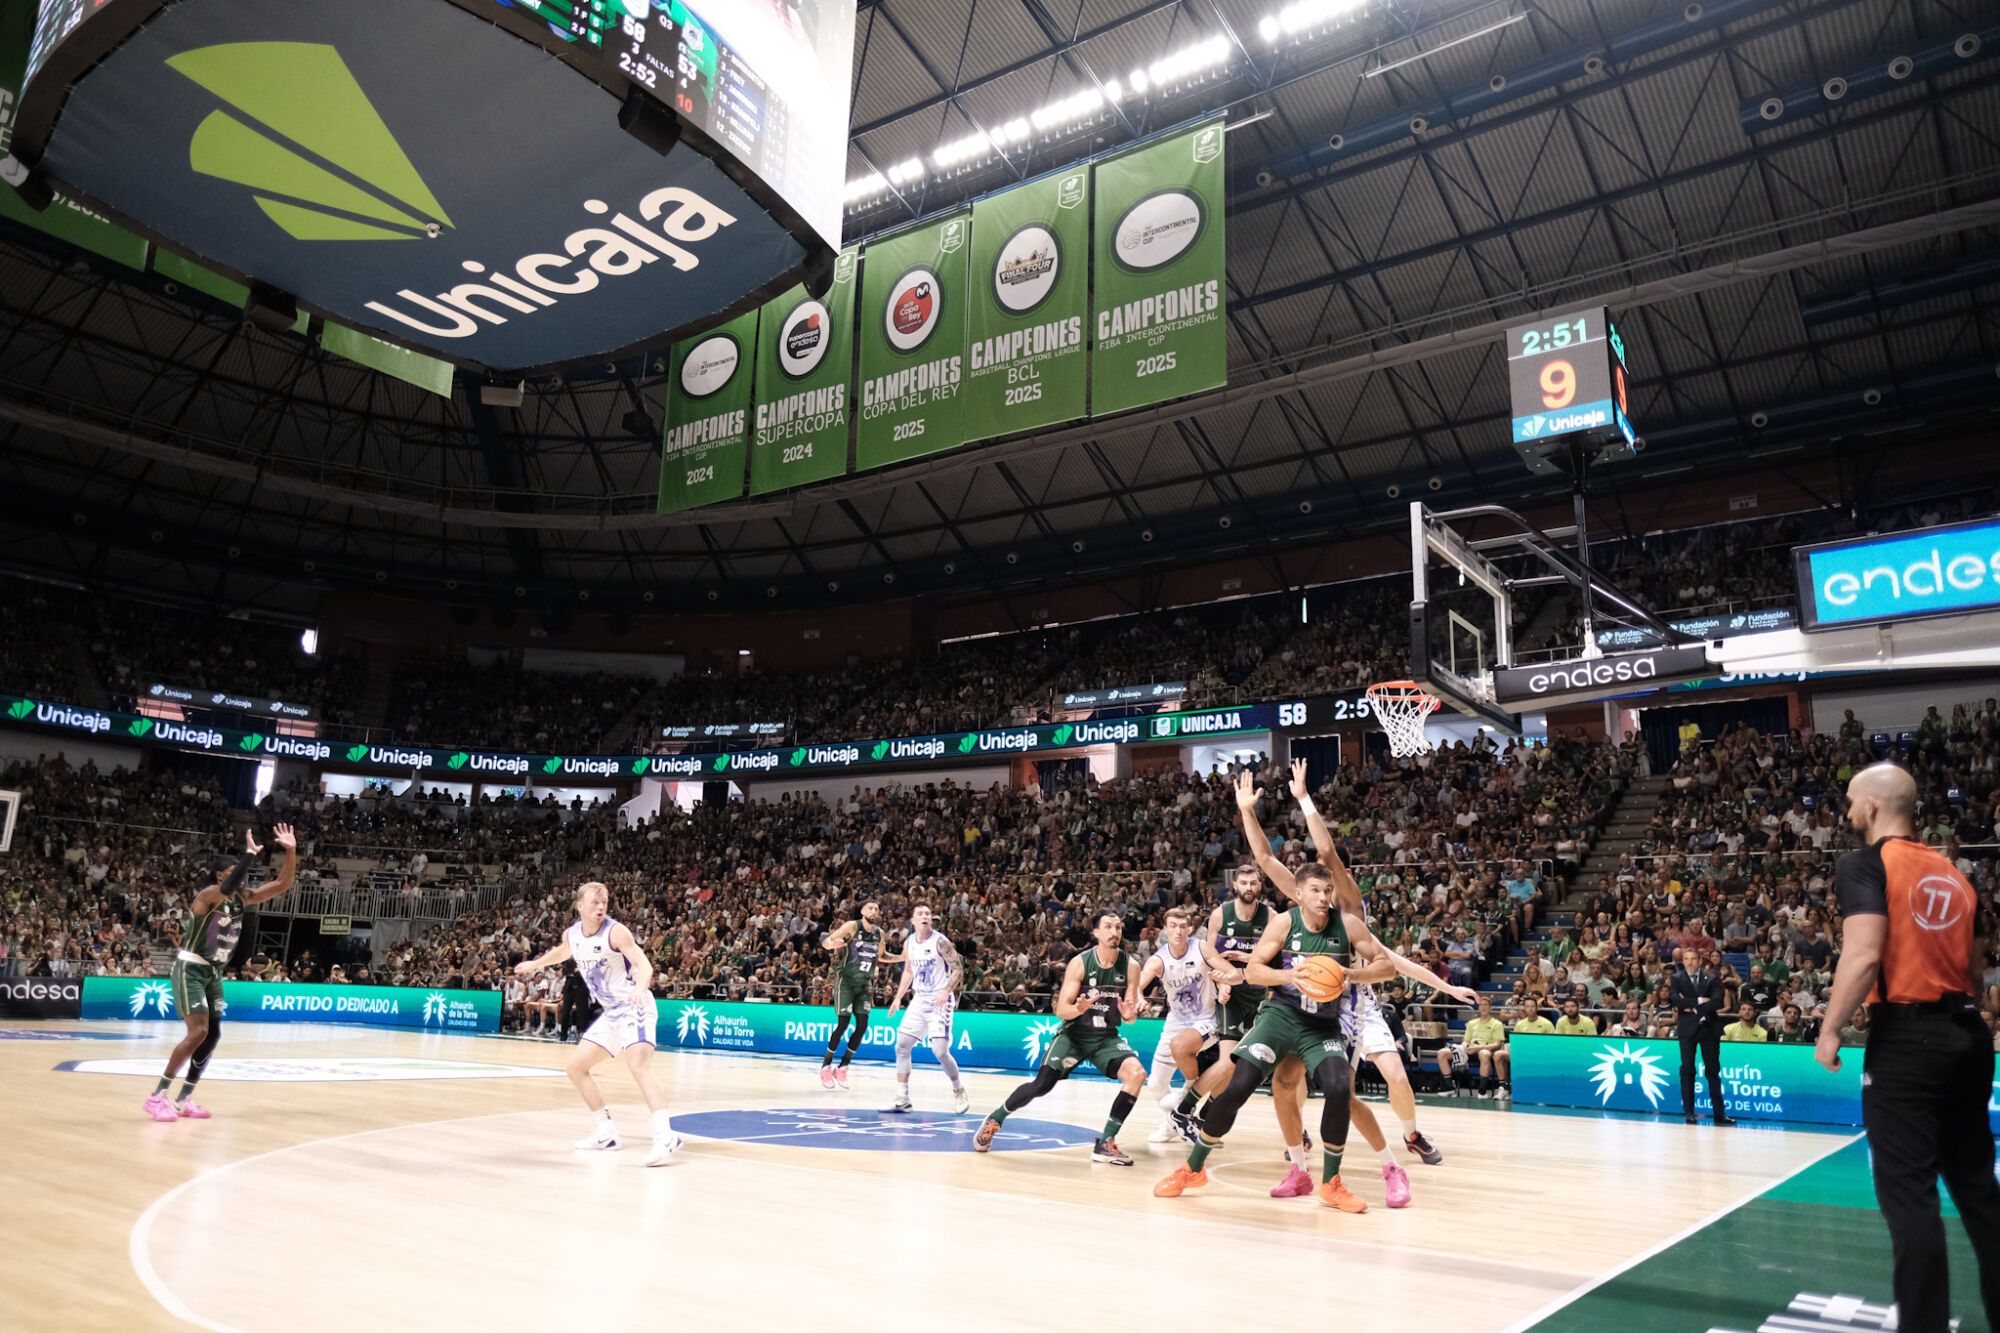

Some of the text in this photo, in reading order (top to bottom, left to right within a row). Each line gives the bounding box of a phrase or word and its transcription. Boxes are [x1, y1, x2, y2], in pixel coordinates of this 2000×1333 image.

[623, 14, 645, 43] 58
[659, 14, 673, 31] Q3
[619, 52, 656, 89] 2:52
[645, 53, 675, 79] FALTAS
[678, 53, 697, 81] 53
[678, 93, 693, 113] 10
[364, 185, 737, 341] Unicaja
[1026, 260, 1052, 273] FOUR
[1098, 279, 1218, 341] CAMPEONES
[1099, 313, 1218, 350] FIBA INTERCONTINENTAL
[1147, 335, 1165, 348] CUP
[1522, 318, 1587, 355] 2:51
[971, 316, 1081, 370] CAMPEONES
[970, 344, 1081, 378] BASKETBALL CHAMPIONS LEAGUE
[1136, 351, 1177, 378] 2025
[863, 356, 961, 407] CAMPEONES
[1008, 363, 1040, 385] BCL
[1540, 360, 1577, 410] 9
[863, 383, 960, 420] COPA DEL REY
[1005, 382, 1042, 406] 2025
[756, 383, 845, 429] CAMPEONES
[667, 409, 745, 453] CAMPEONES
[756, 410, 845, 446] SUPERCOPA
[893, 418, 926, 441] 2025
[1549, 410, 1606, 432] Unicaja
[681, 435, 743, 457] INTERCONTINENTAL
[783, 442, 813, 463] 2024
[686, 465, 714, 486] 2024
[1748, 610, 1790, 622] Fundación
[1528, 656, 1657, 694] endesa
[165, 688, 192, 700] Unicaja
[225, 697, 252, 709] Unicaja
[36, 704, 111, 734] Unicaja
[282, 705, 309, 717] Unicaja
[1278, 703, 1307, 727] 58
[1334, 699, 1370, 721] 2:5
[1075, 720, 1139, 743] Unicaja
[1182, 712, 1242, 733] UNICAJA
[154, 721, 223, 748] Unicaja
[979, 730, 1038, 752] Unicaja
[264, 736, 330, 761] Unicaja
[370, 747, 433, 769] Unicaja
[808, 745, 859, 766] Unicaja
[890, 737, 945, 759] Unicaja
[470, 754, 529, 775] Unicaja
[563, 756, 620, 777] Unicaja
[651, 756, 702, 777] Unicaja
[730, 751, 779, 771] Unicaja
[1923, 887, 1952, 920] 77
[860, 961, 872, 972] 27
[0, 979, 79, 1000] ndesa
[1177, 991, 1194, 1003] 73
[261, 994, 399, 1014] PARTIDO DEDICADO A
[463, 1010, 478, 1019] Torre
[714, 1015, 748, 1026] Alhaurín
[713, 1026, 755, 1038] de la Torre
[713, 1037, 754, 1047] CALIDAD DE VIDA
[957, 1030, 973, 1051] A
[1728, 1080, 1782, 1099] Torre
[1734, 1100, 1750, 1111] DE
[1753, 1101, 1783, 1113] VIDA
